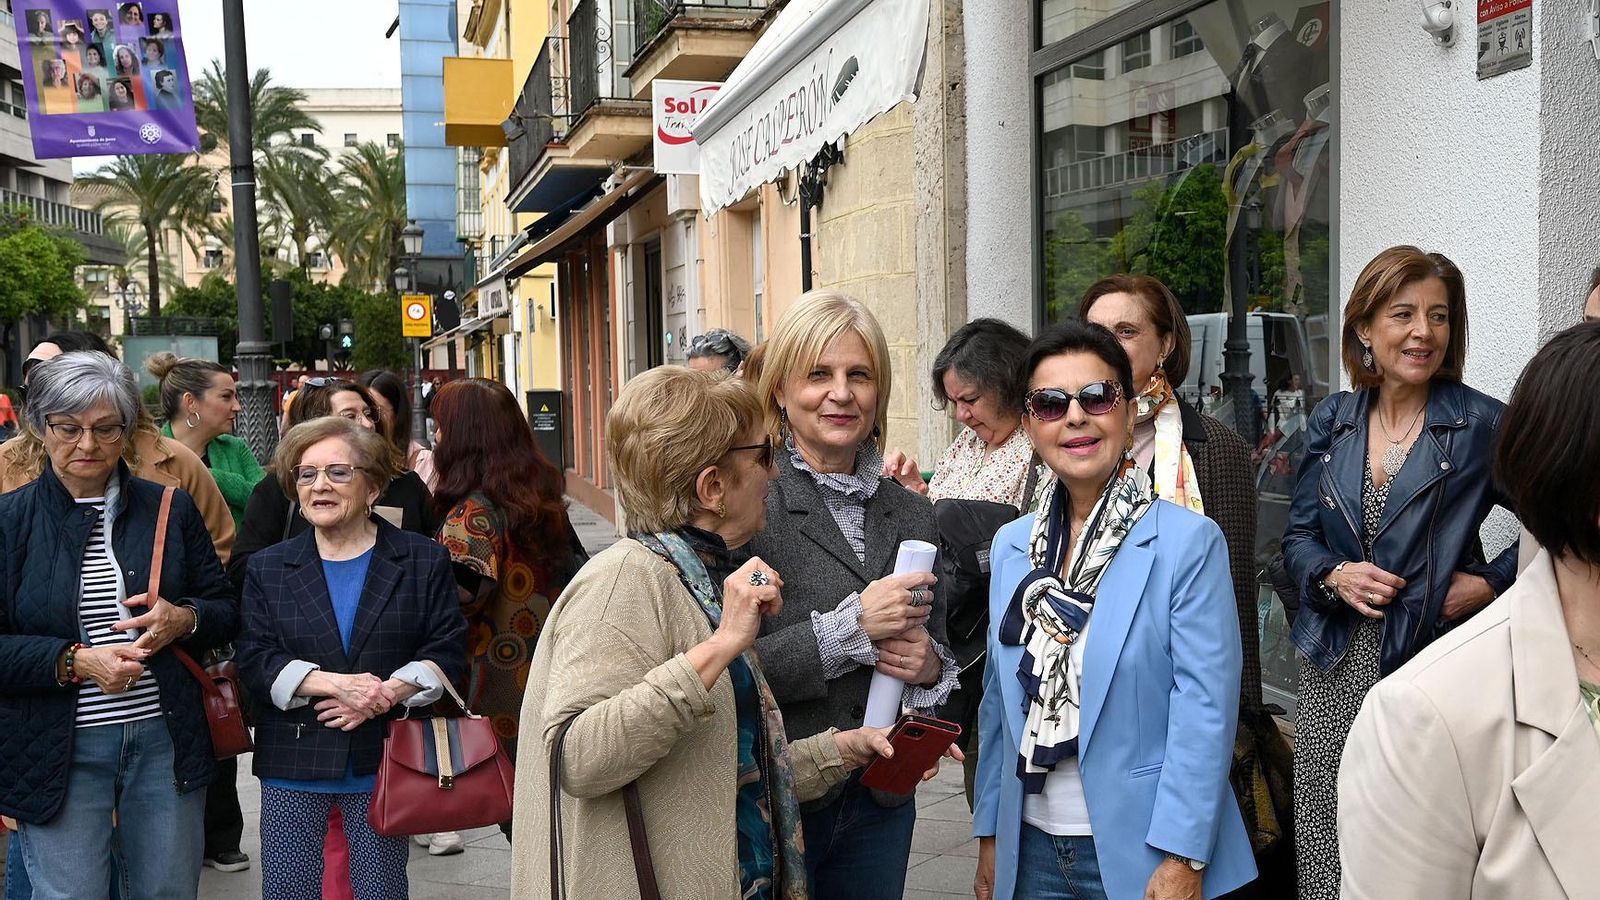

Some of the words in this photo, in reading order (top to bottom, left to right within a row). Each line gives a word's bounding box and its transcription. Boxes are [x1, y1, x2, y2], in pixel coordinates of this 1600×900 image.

[1489, 3, 1504, 14] Aviso
[664, 96, 696, 114] Sol
[727, 112, 754, 195] JOSÉ
